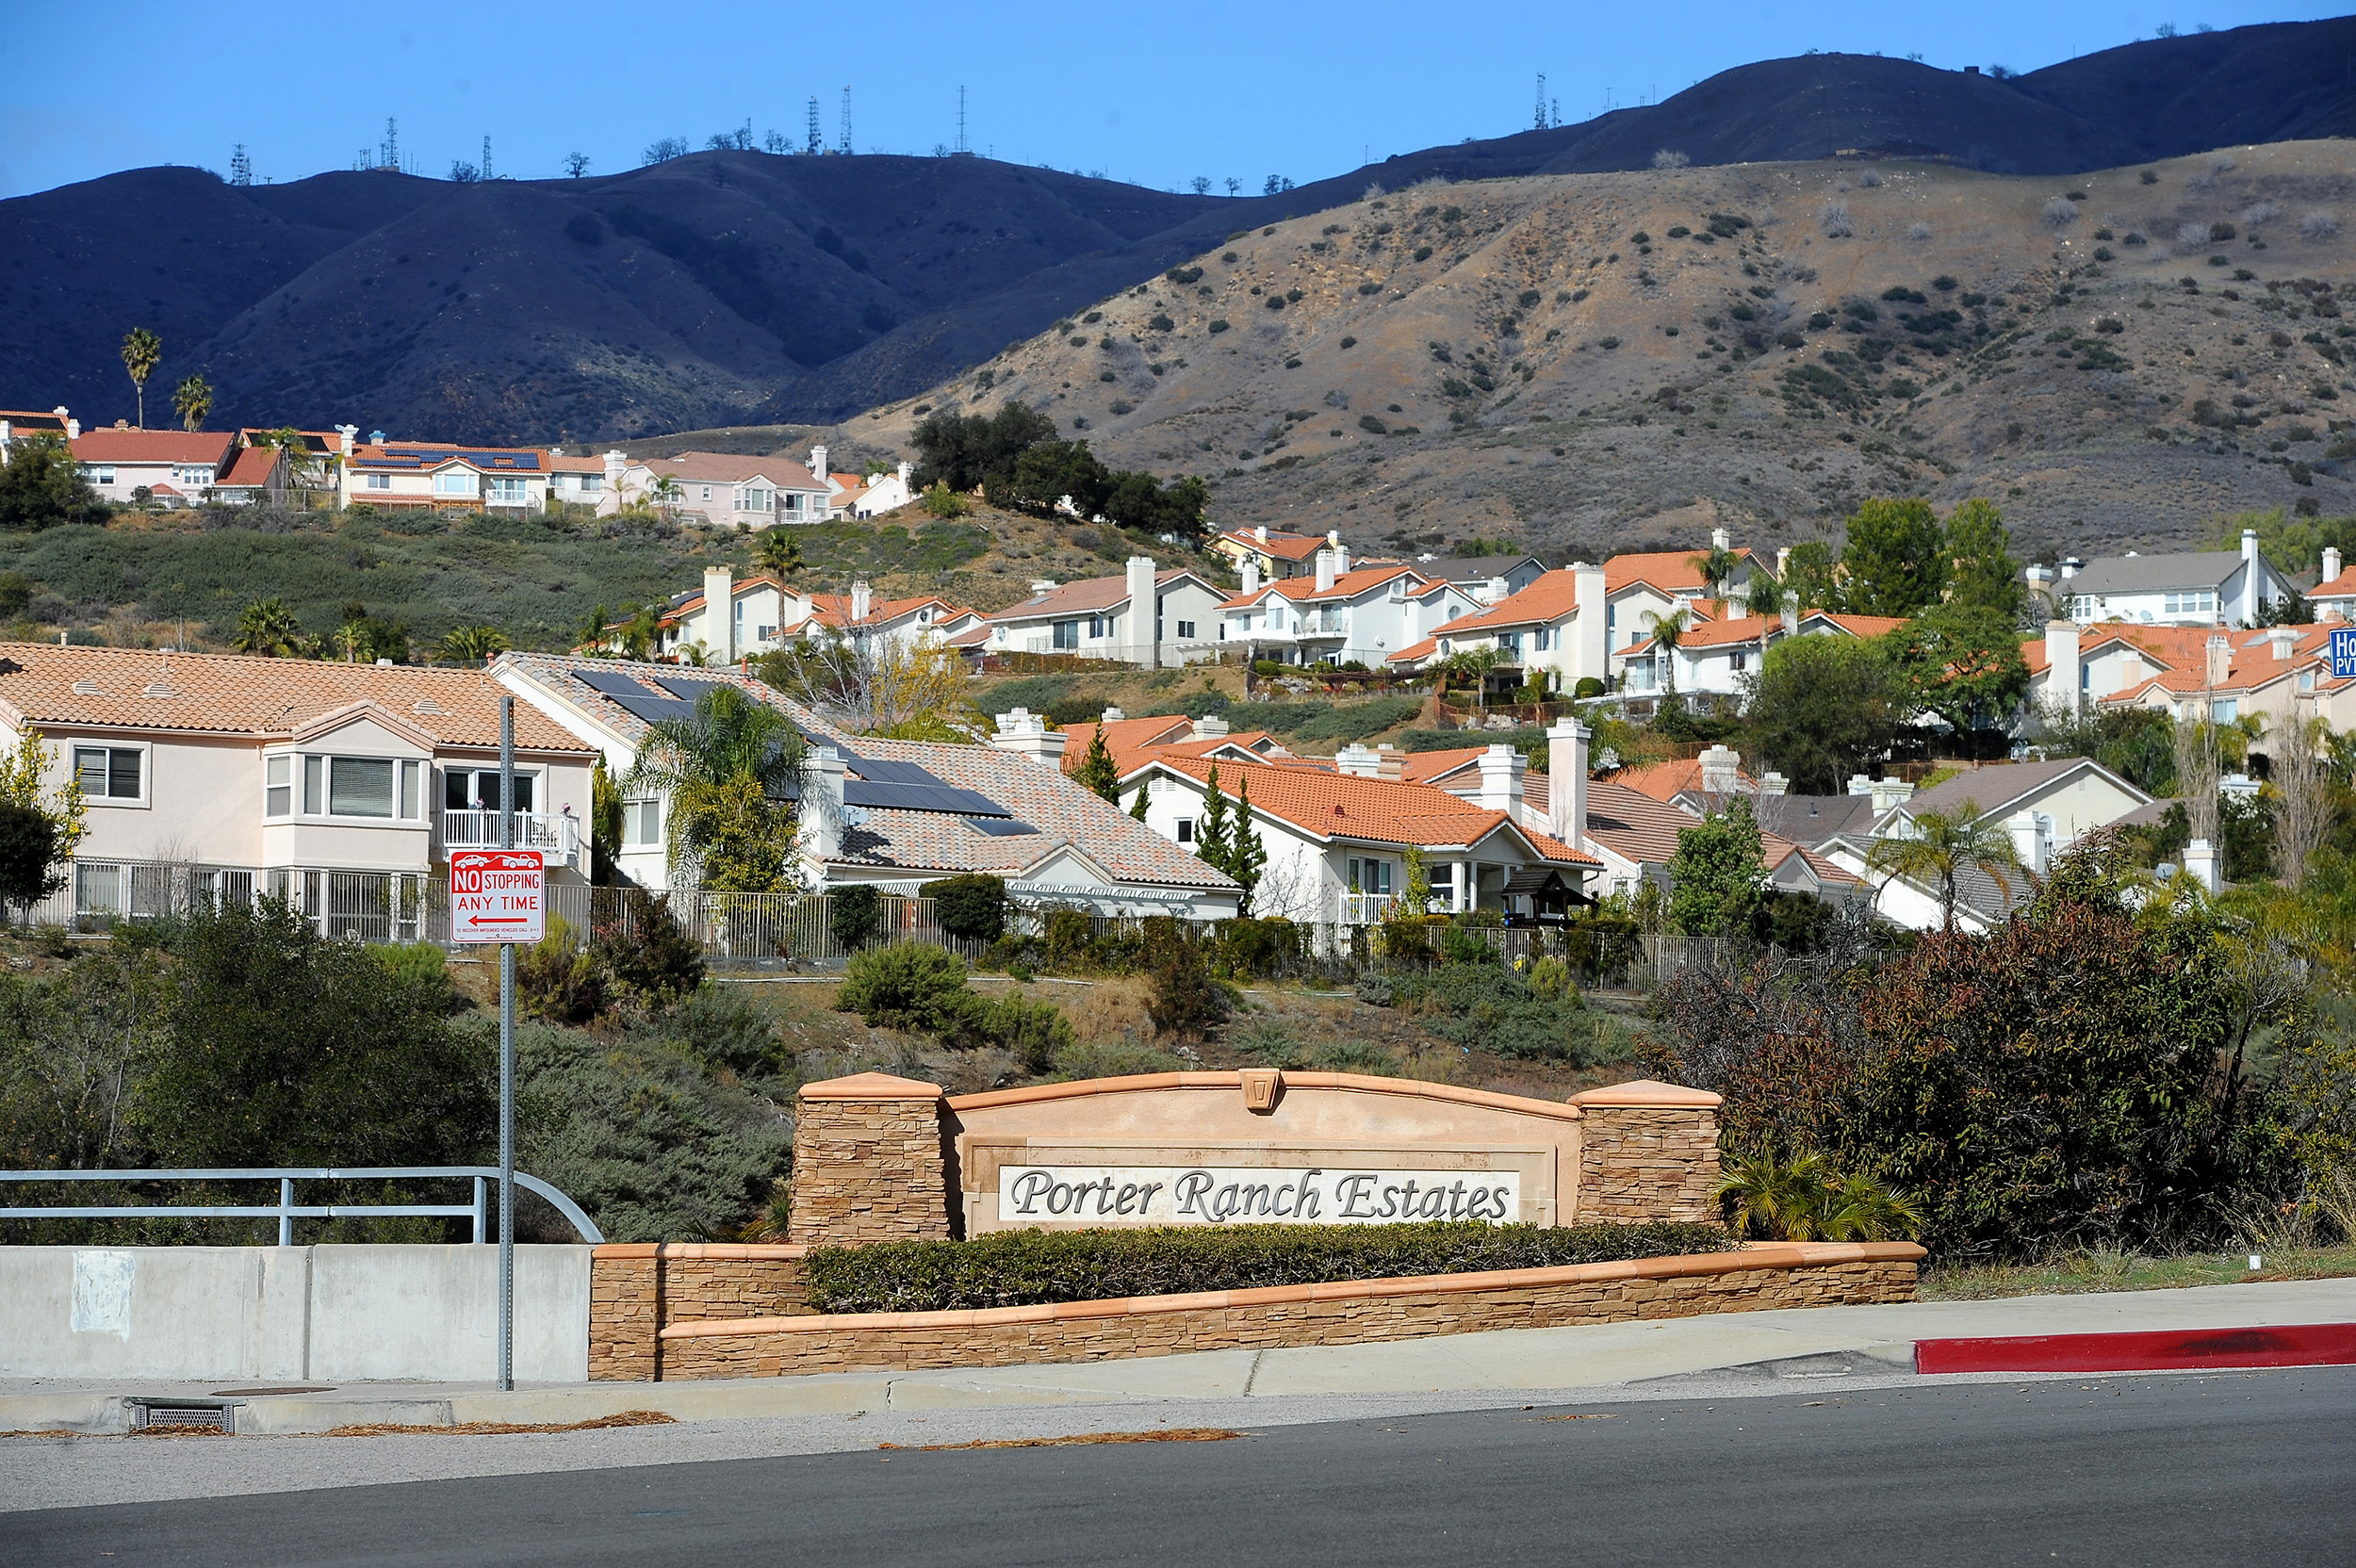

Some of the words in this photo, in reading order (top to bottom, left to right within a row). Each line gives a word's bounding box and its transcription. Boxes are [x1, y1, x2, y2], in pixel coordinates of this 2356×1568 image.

[454, 870, 481, 891] NO
[484, 874, 540, 890] STOPPING
[457, 896, 494, 911] ANY
[500, 896, 538, 910] TIME
[1011, 1169, 1163, 1215] Porter
[1174, 1168, 1322, 1223] Ranch
[1335, 1174, 1510, 1219] Estates
